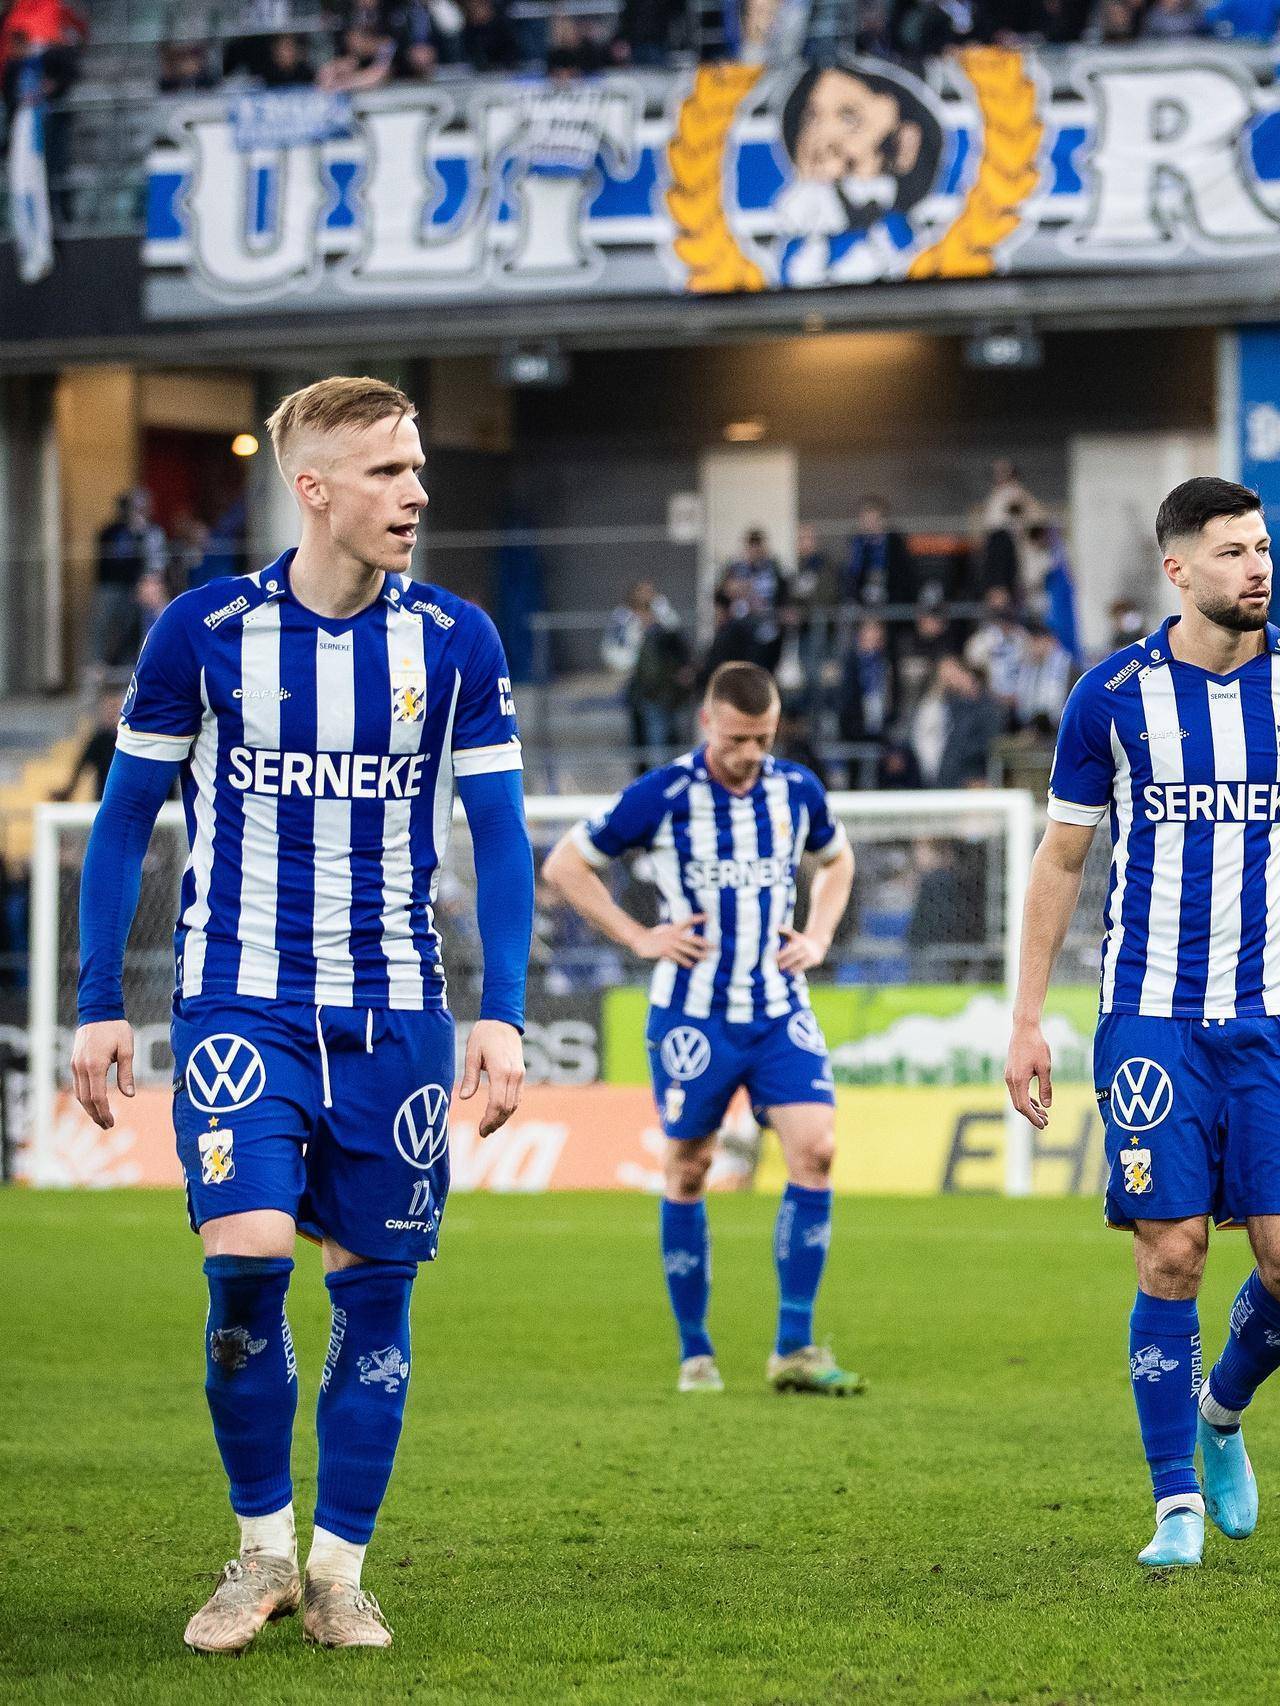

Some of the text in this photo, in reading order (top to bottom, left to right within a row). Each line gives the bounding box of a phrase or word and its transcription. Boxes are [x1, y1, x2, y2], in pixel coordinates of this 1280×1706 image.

[204, 596, 248, 628] FAMECO
[411, 600, 455, 629] FAMECO
[319, 642, 351, 652] SERNEKE
[1104, 659, 1142, 691] FAMECO
[232, 688, 278, 699] CRAFT
[1210, 692, 1238, 700] SERNEKE
[228, 747, 424, 799] SERNEKE
[385, 1219, 424, 1231] CRAFT
